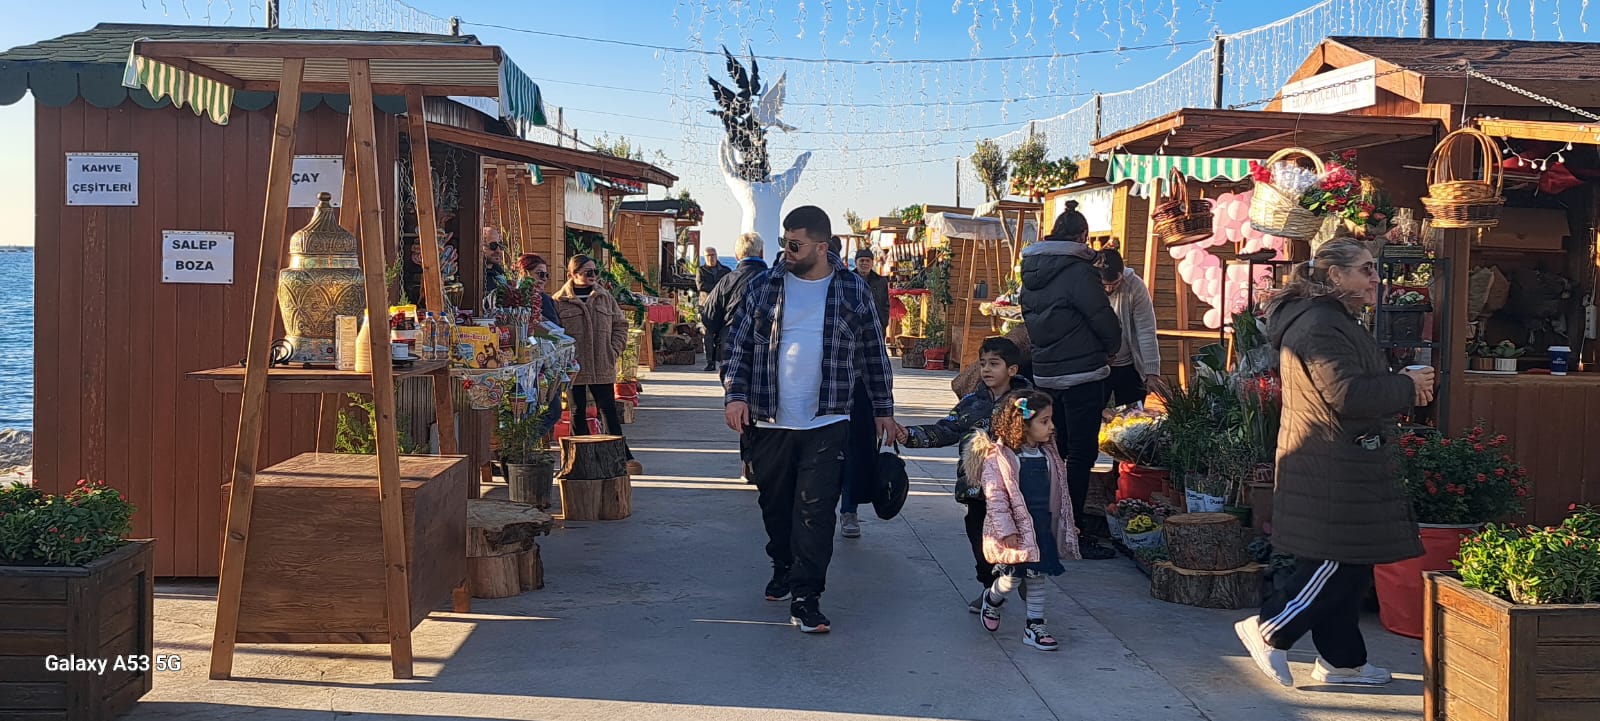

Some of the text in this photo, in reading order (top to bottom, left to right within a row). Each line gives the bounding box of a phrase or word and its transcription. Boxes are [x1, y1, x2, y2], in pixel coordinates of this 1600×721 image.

[82, 164, 122, 173] KAHVE
[291, 172, 320, 185] ÇAY
[72, 182, 132, 194] ÇEŞİTLERİ
[172, 240, 217, 250] SALEP
[175, 260, 214, 271] BOZA
